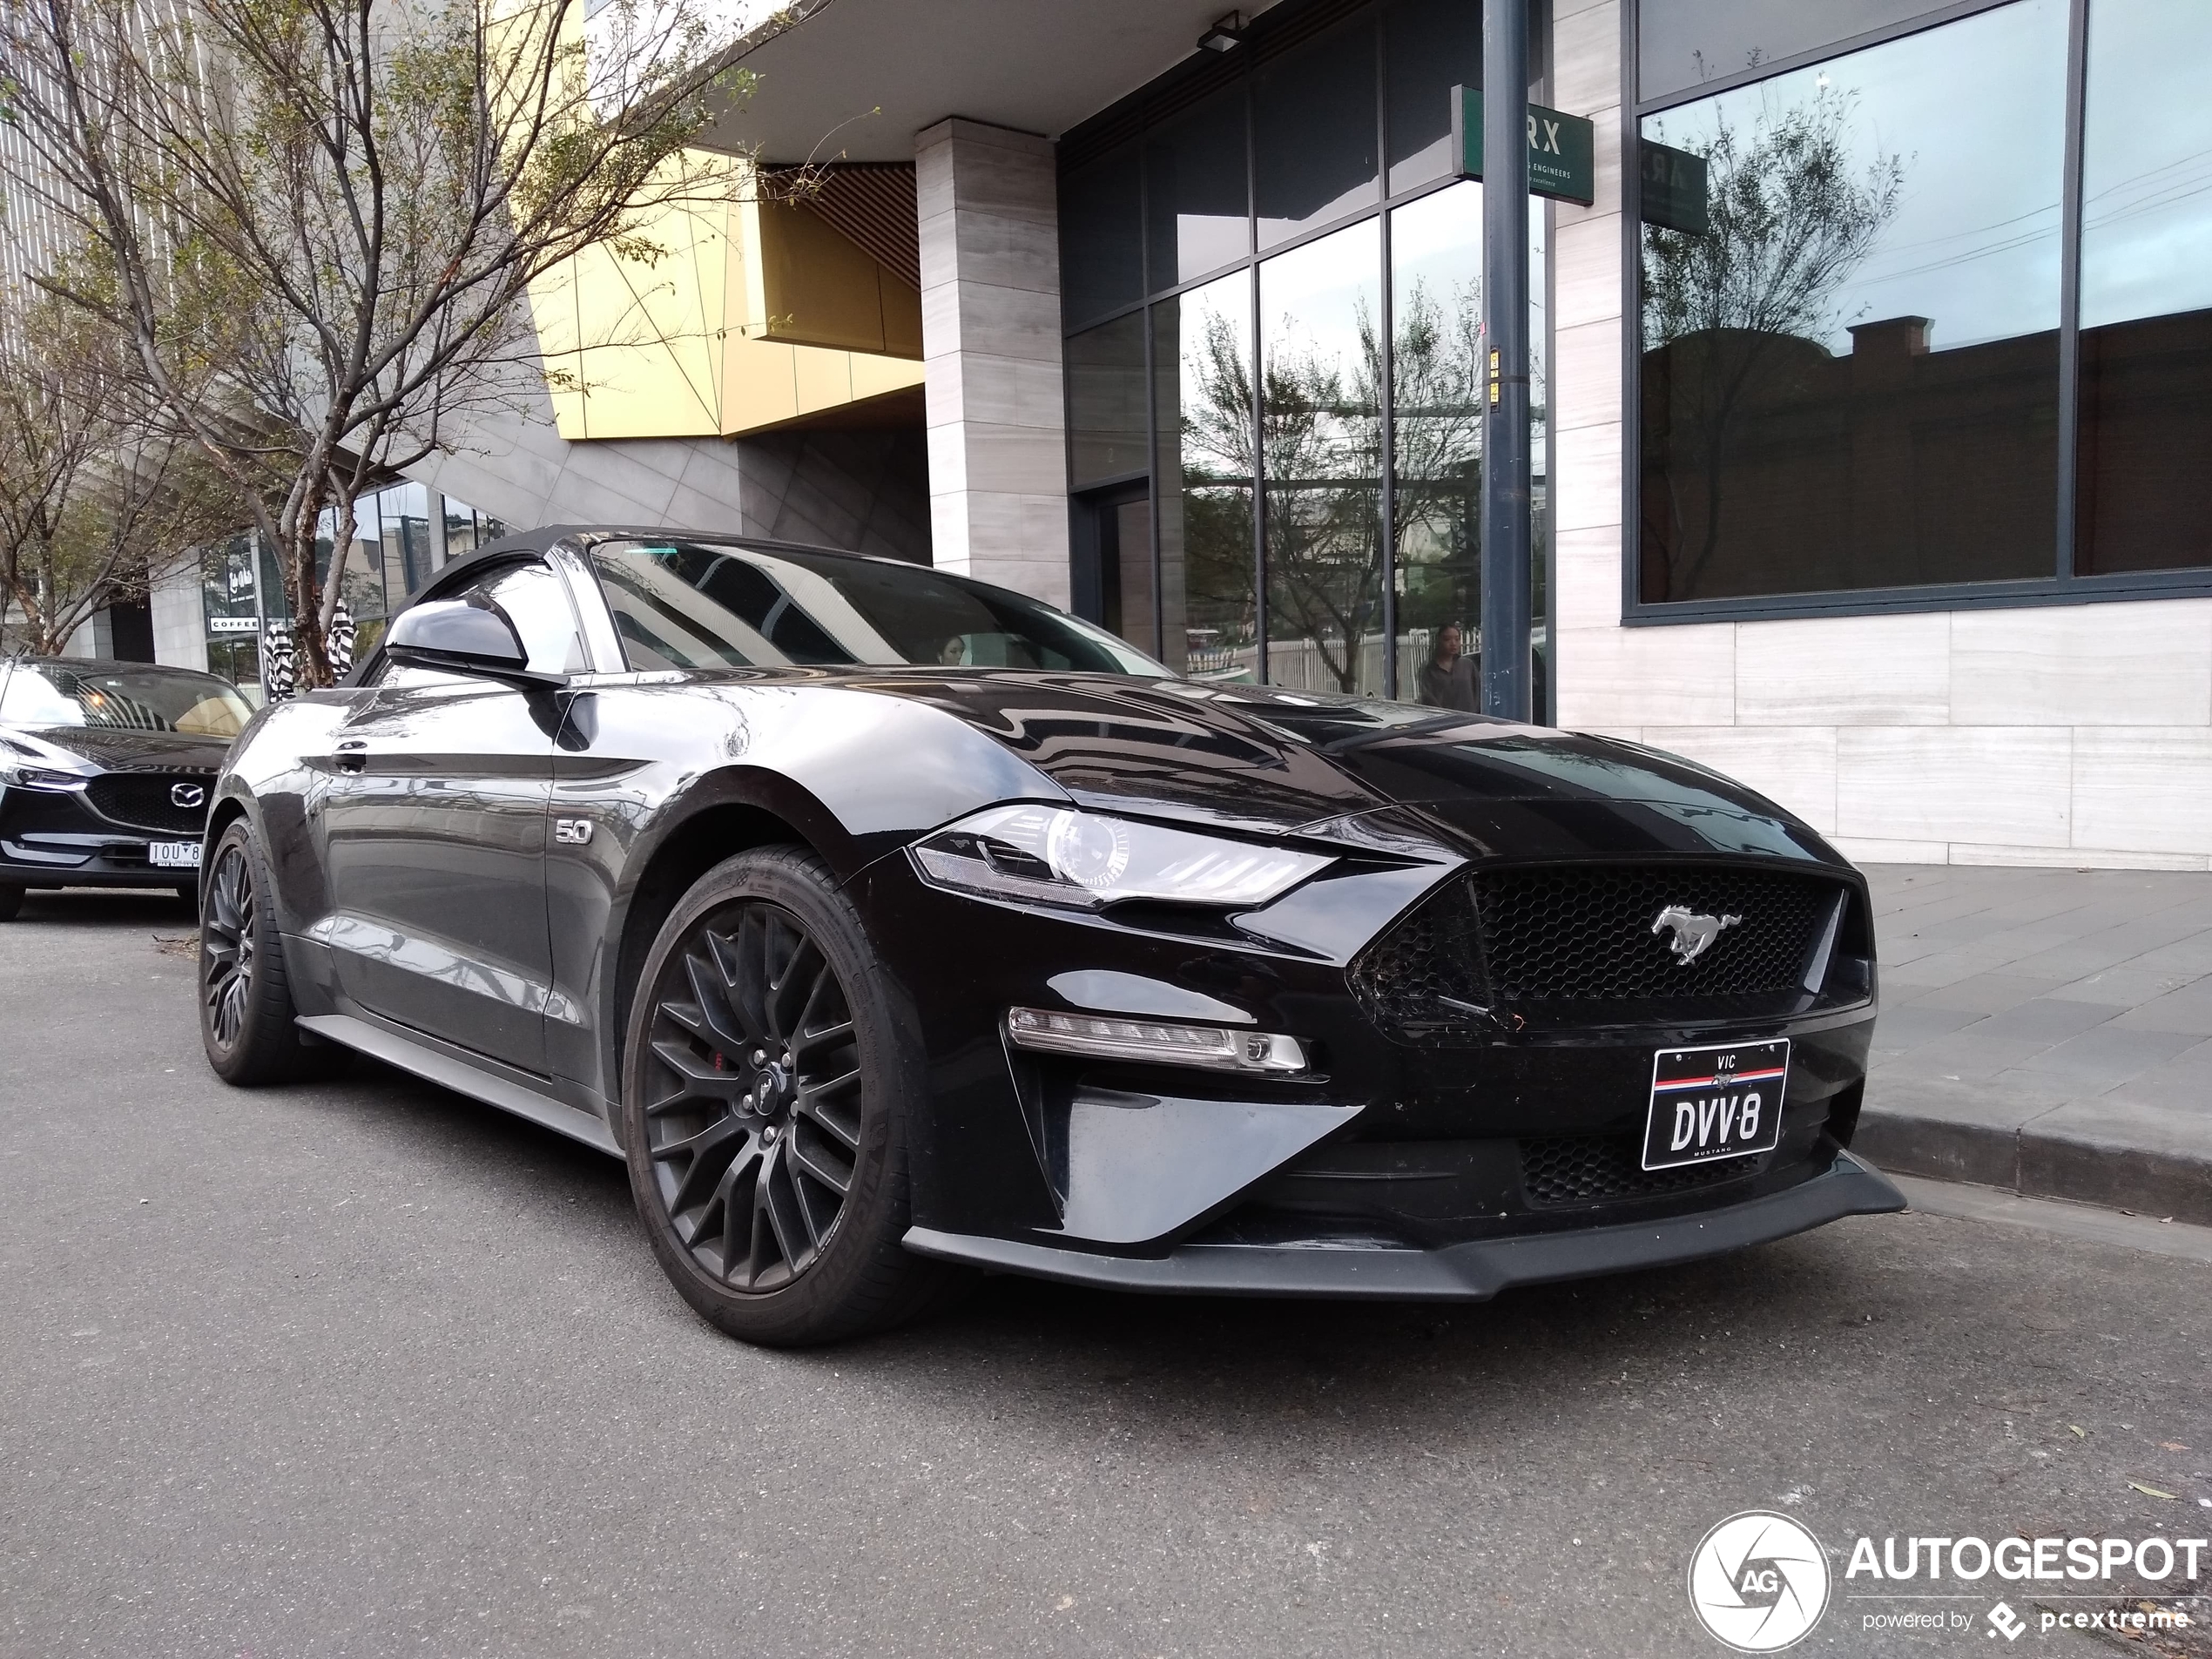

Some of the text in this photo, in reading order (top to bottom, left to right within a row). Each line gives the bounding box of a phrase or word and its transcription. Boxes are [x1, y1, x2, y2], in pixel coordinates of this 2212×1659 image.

[1528, 114, 1561, 155] RX
[1533, 163, 1571, 179] ENGINEERS
[1717, 1054, 1737, 1069] VIC
[1694, 1146, 1732, 1157] MUSTANG
